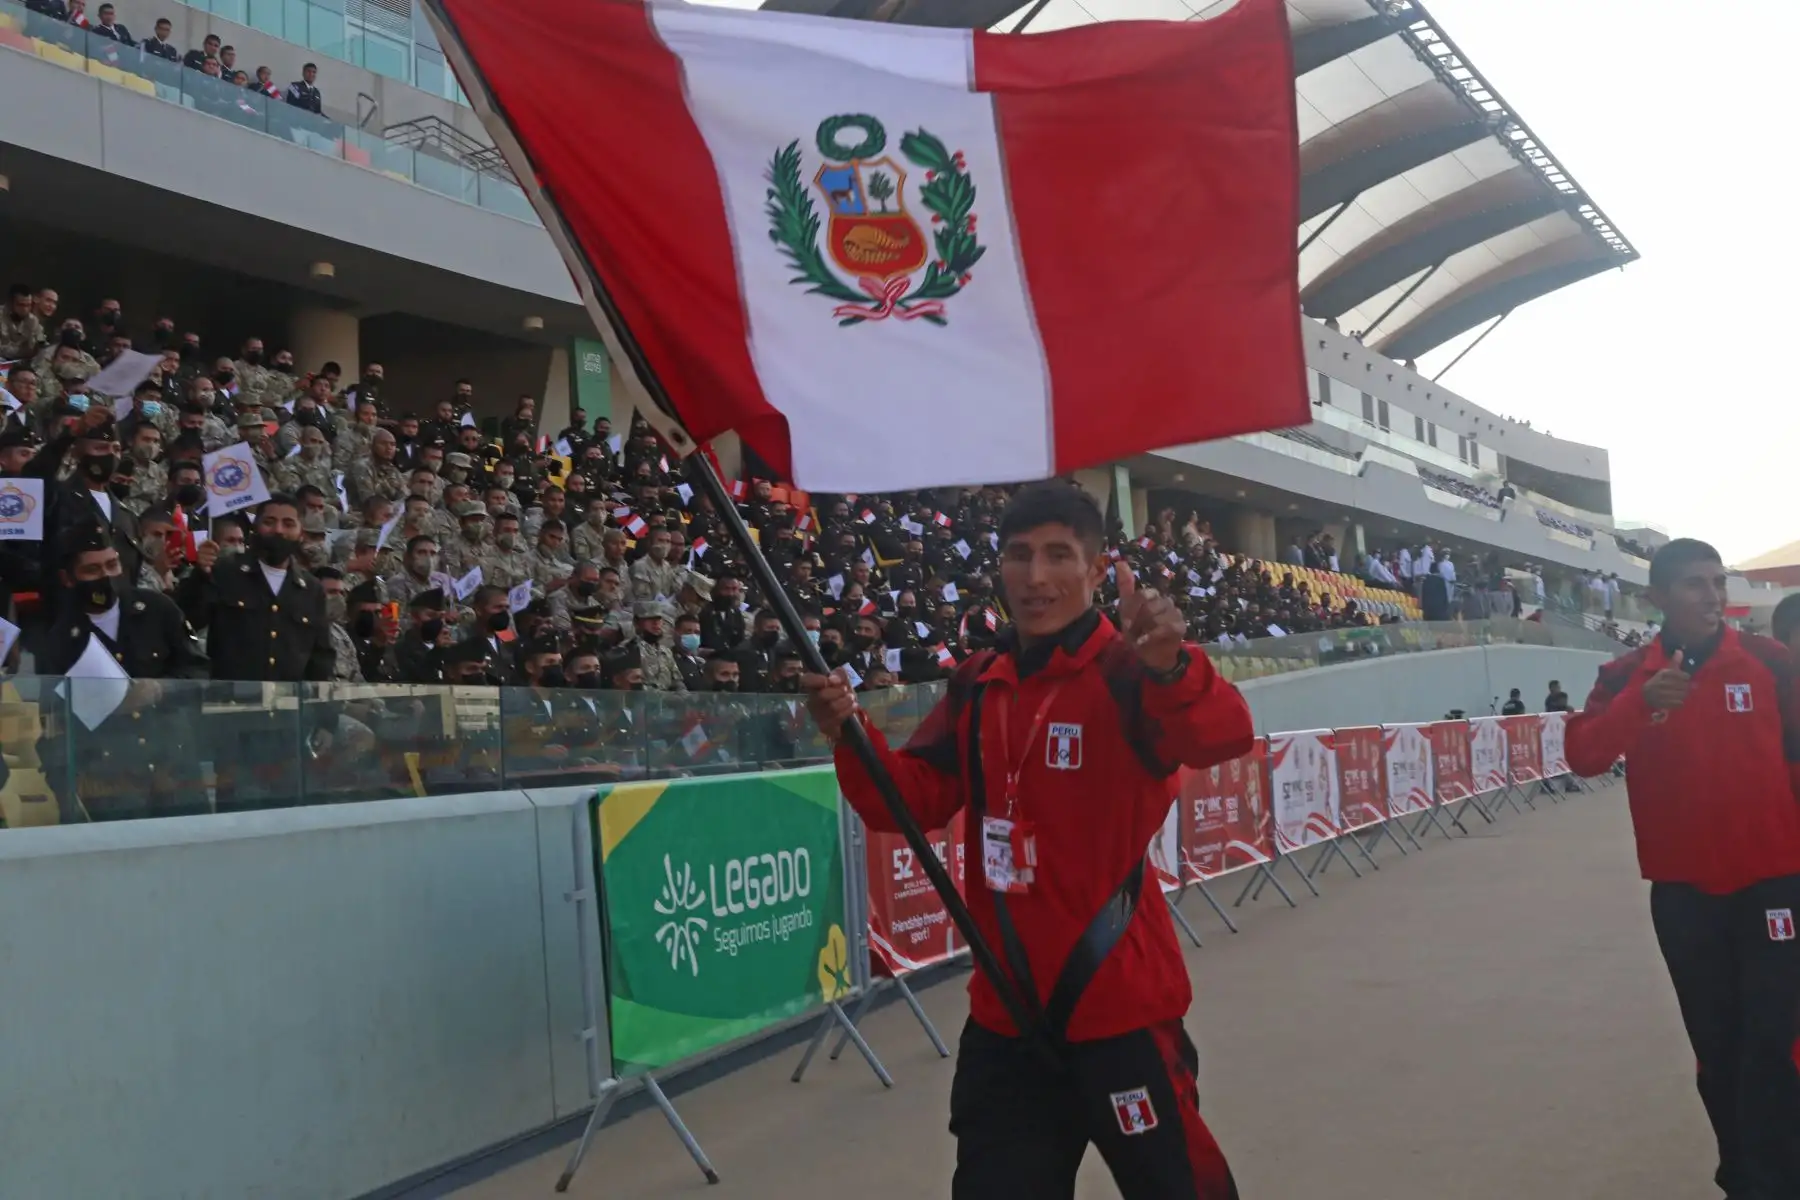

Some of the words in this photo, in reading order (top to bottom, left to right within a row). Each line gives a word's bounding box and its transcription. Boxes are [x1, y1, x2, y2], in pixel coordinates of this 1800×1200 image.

[1052, 726, 1078, 736] PERU
[714, 922, 771, 956] Seguimos
[772, 902, 813, 944] jugando
